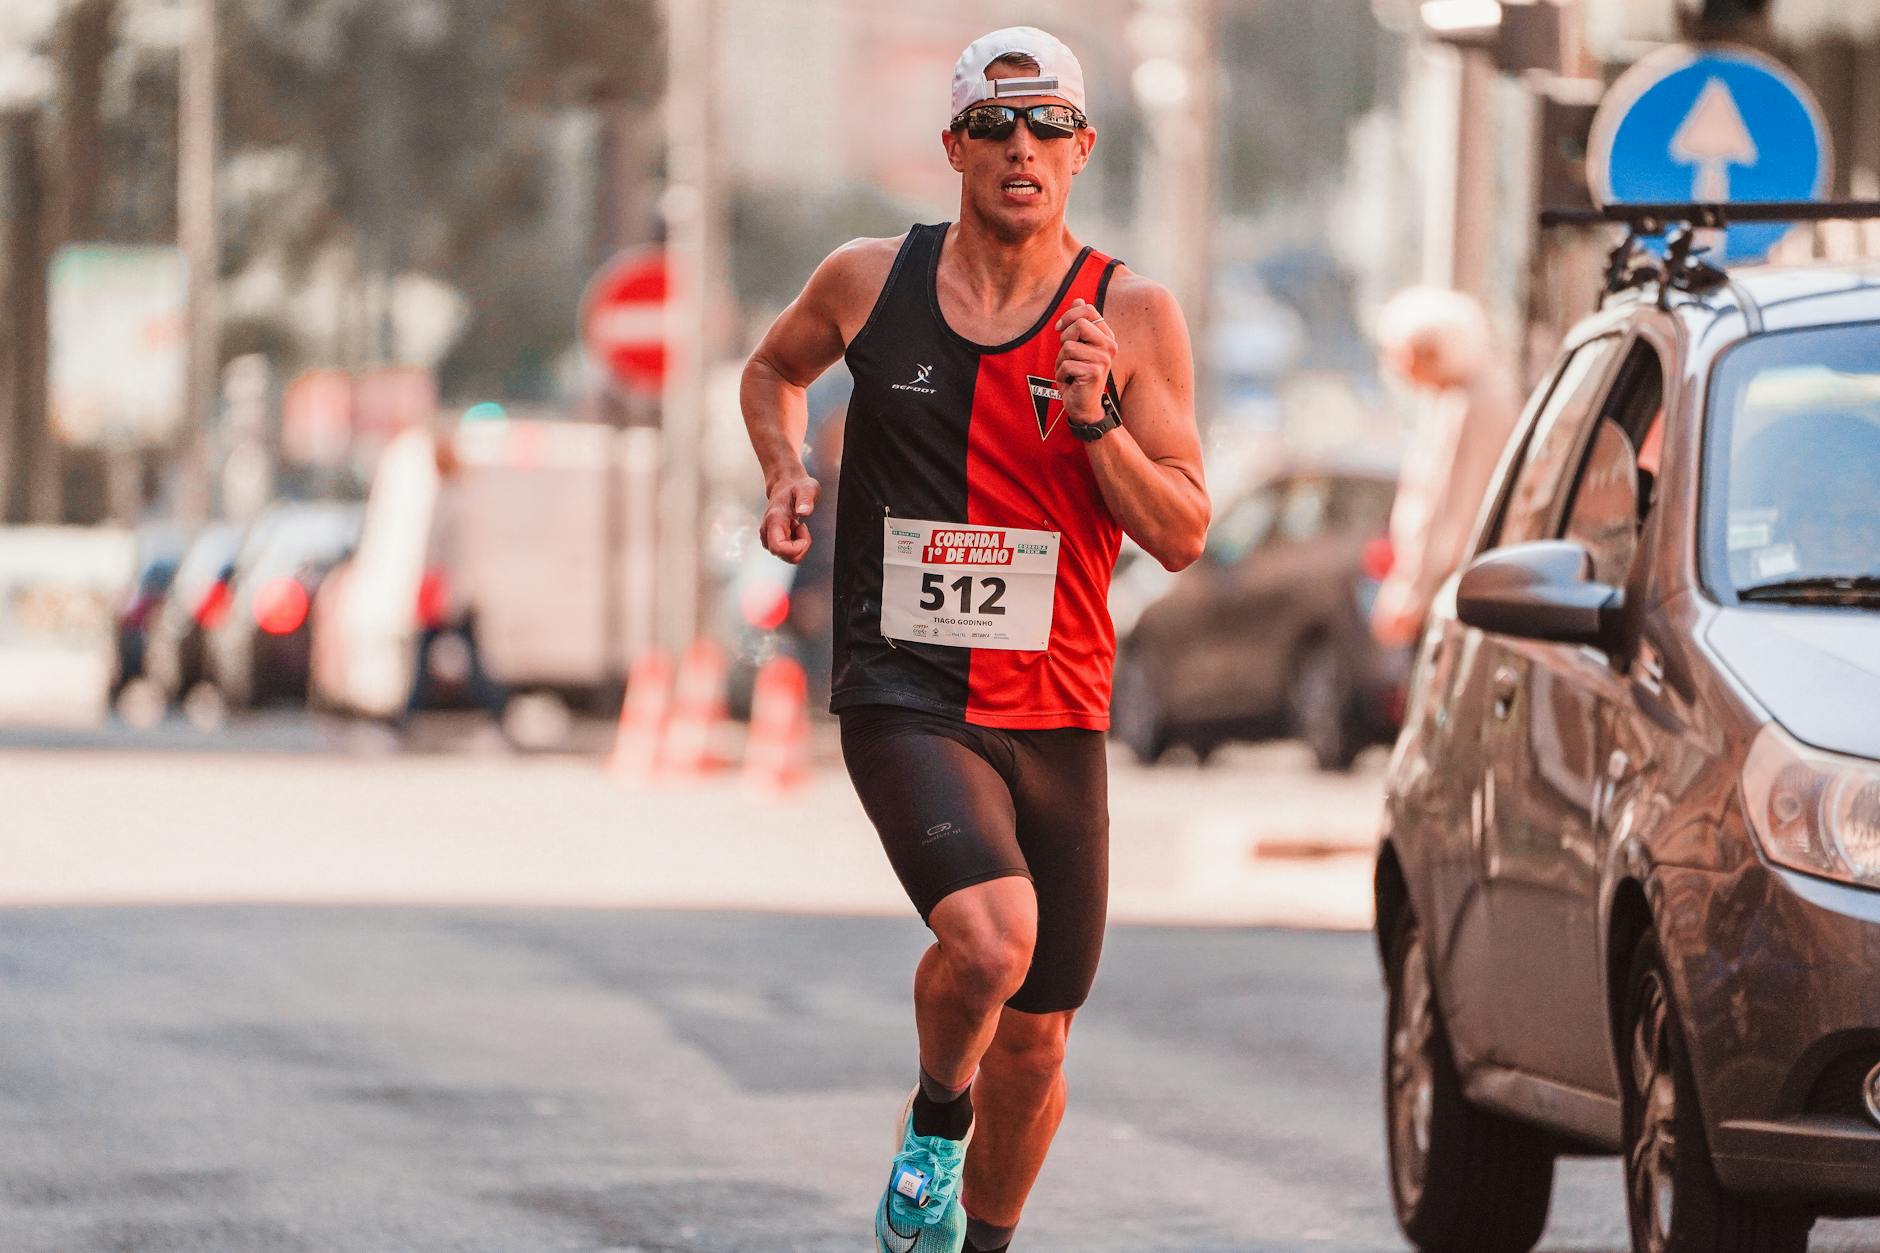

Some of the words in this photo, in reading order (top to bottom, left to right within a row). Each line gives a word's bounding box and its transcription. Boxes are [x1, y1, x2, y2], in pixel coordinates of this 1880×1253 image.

[934, 531, 1000, 548] CORRIDA
[945, 547, 966, 563] DE
[968, 548, 1009, 564] MAIO
[919, 572, 1007, 616] 512
[934, 617, 956, 625] TIAGO
[957, 619, 993, 627] GODINHO
